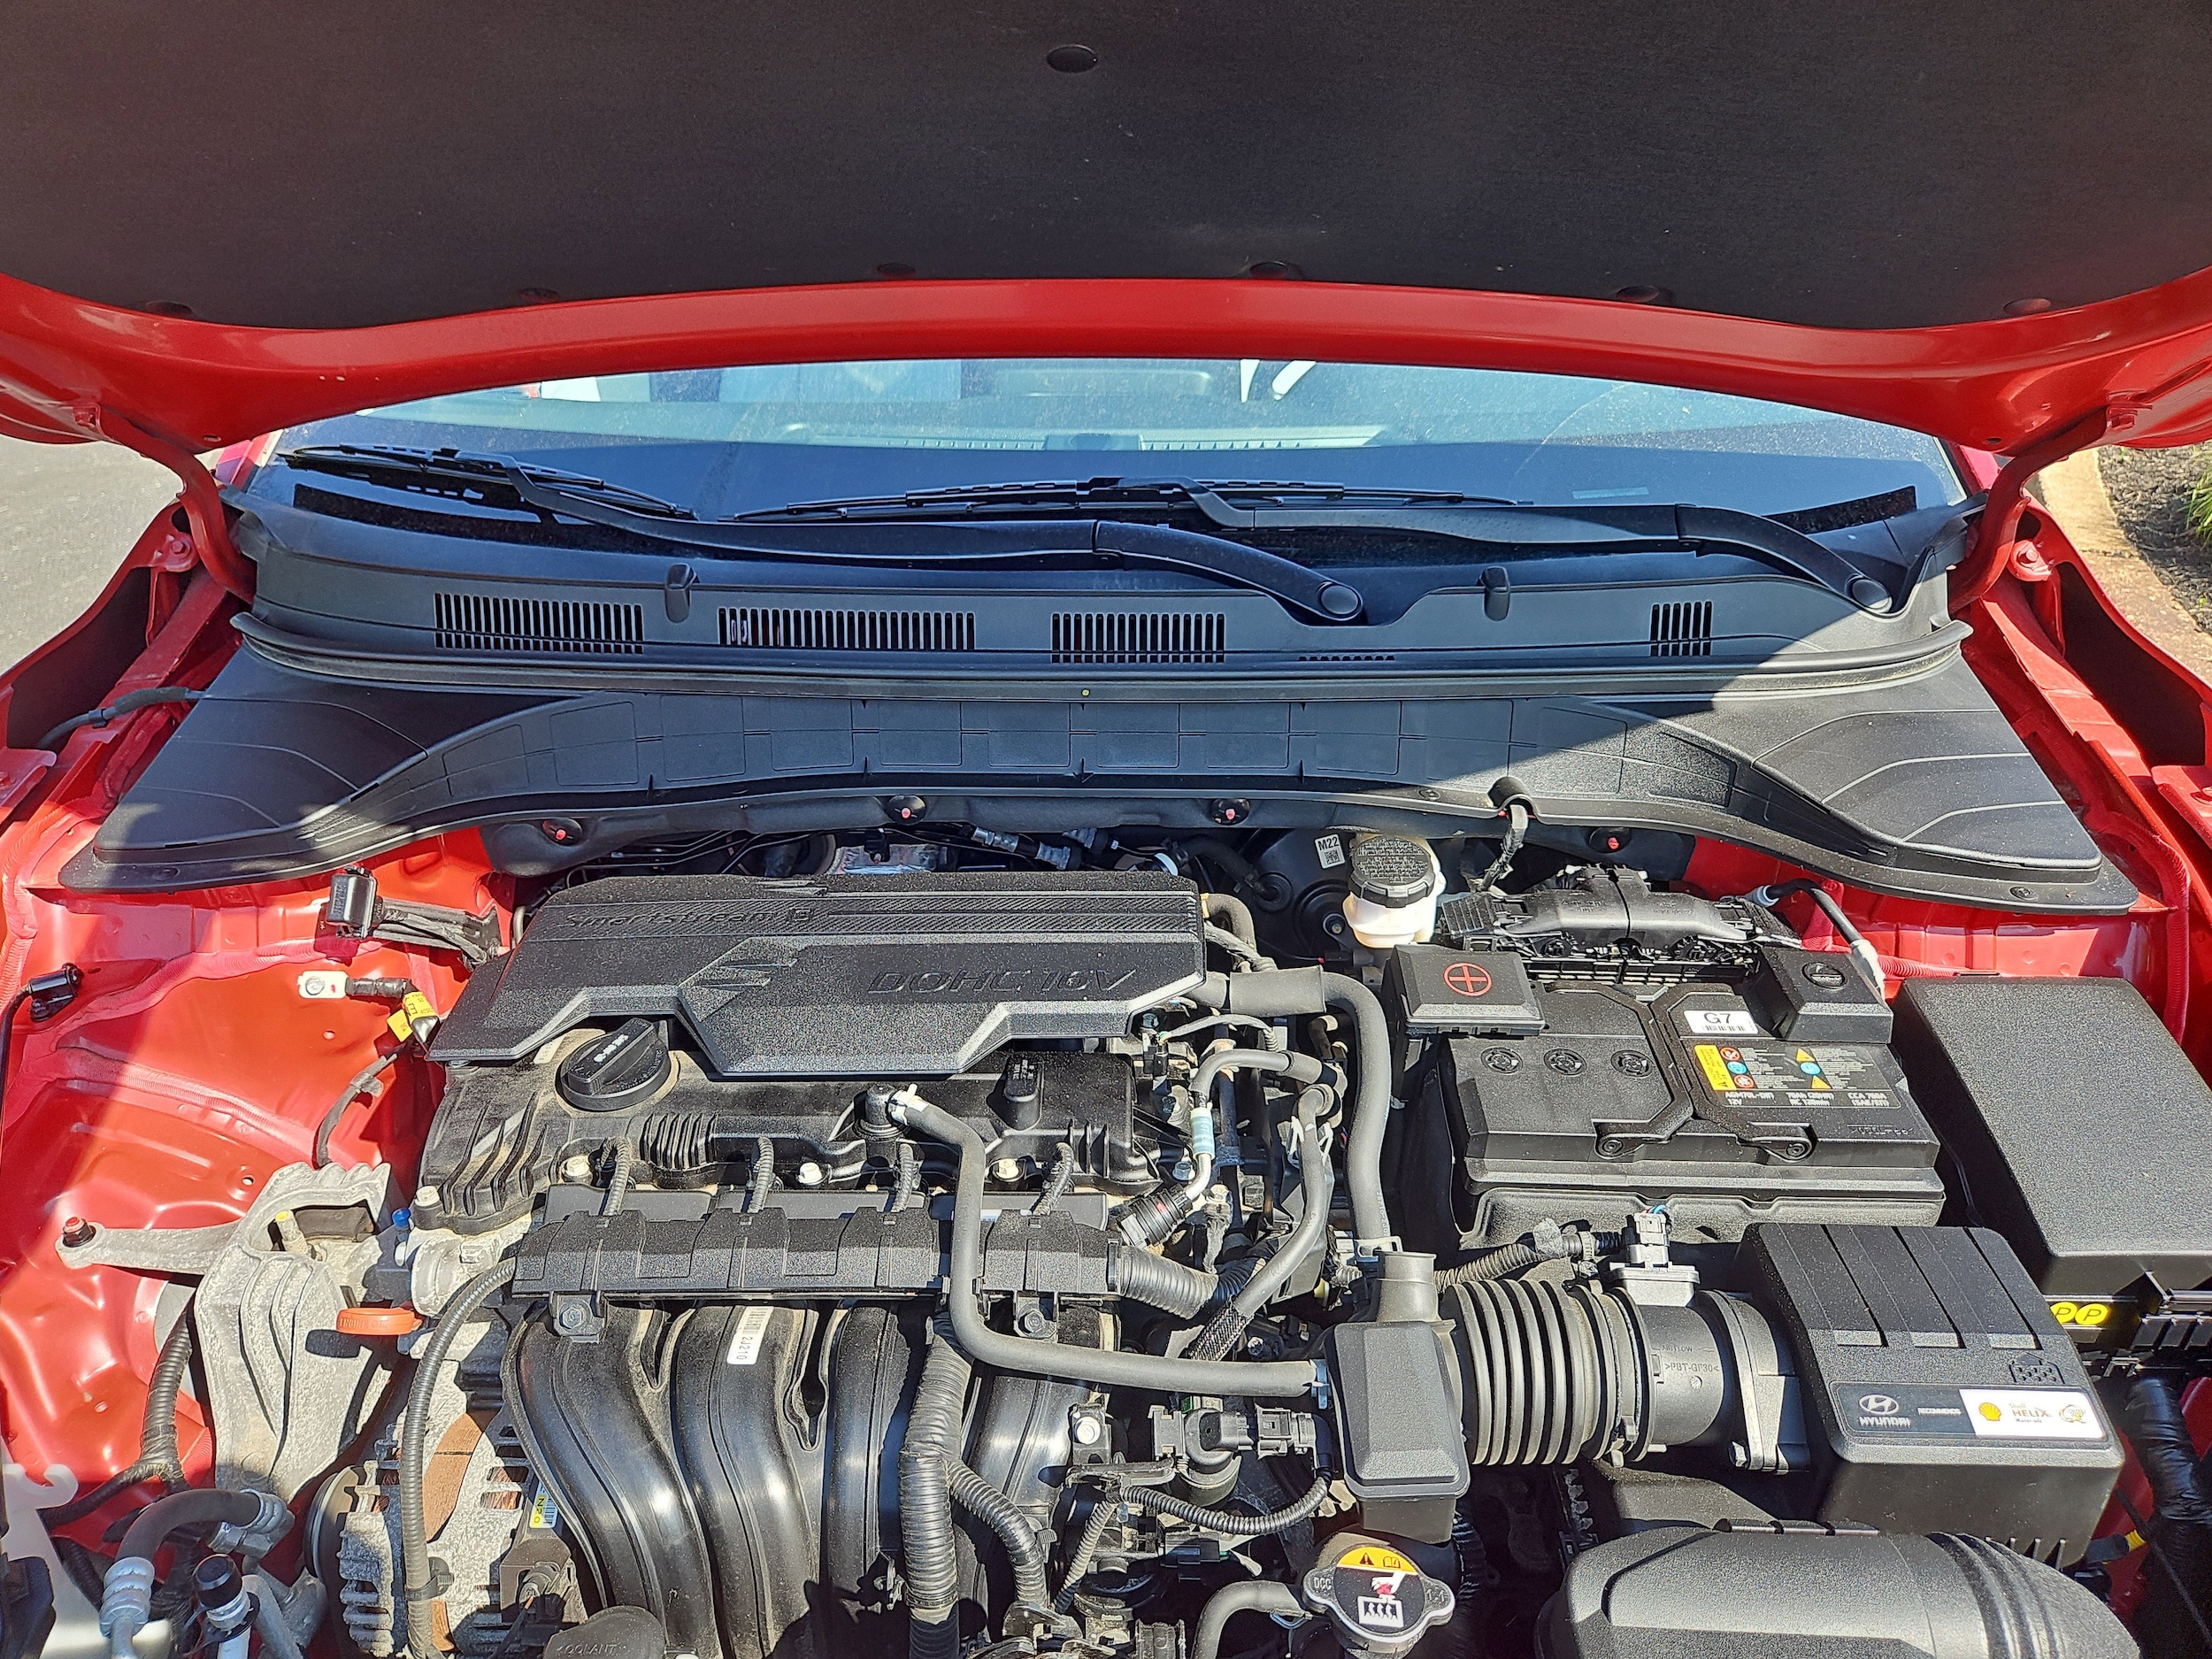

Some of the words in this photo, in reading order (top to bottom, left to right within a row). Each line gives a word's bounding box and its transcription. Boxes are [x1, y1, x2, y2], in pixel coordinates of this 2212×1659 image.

[1317, 836, 1340, 851] M22
[867, 970, 1032, 994] DOHC
[1040, 969, 1137, 992] 16V
[1703, 1012, 1731, 1025] G7
[2055, 1307, 2071, 1317] P
[2083, 1309, 2101, 1321] P
[736, 1336, 753, 1360] 2J210
[1859, 1416, 1911, 1429] HYUNDAI
[1313, 1577, 1333, 1590] DCC
